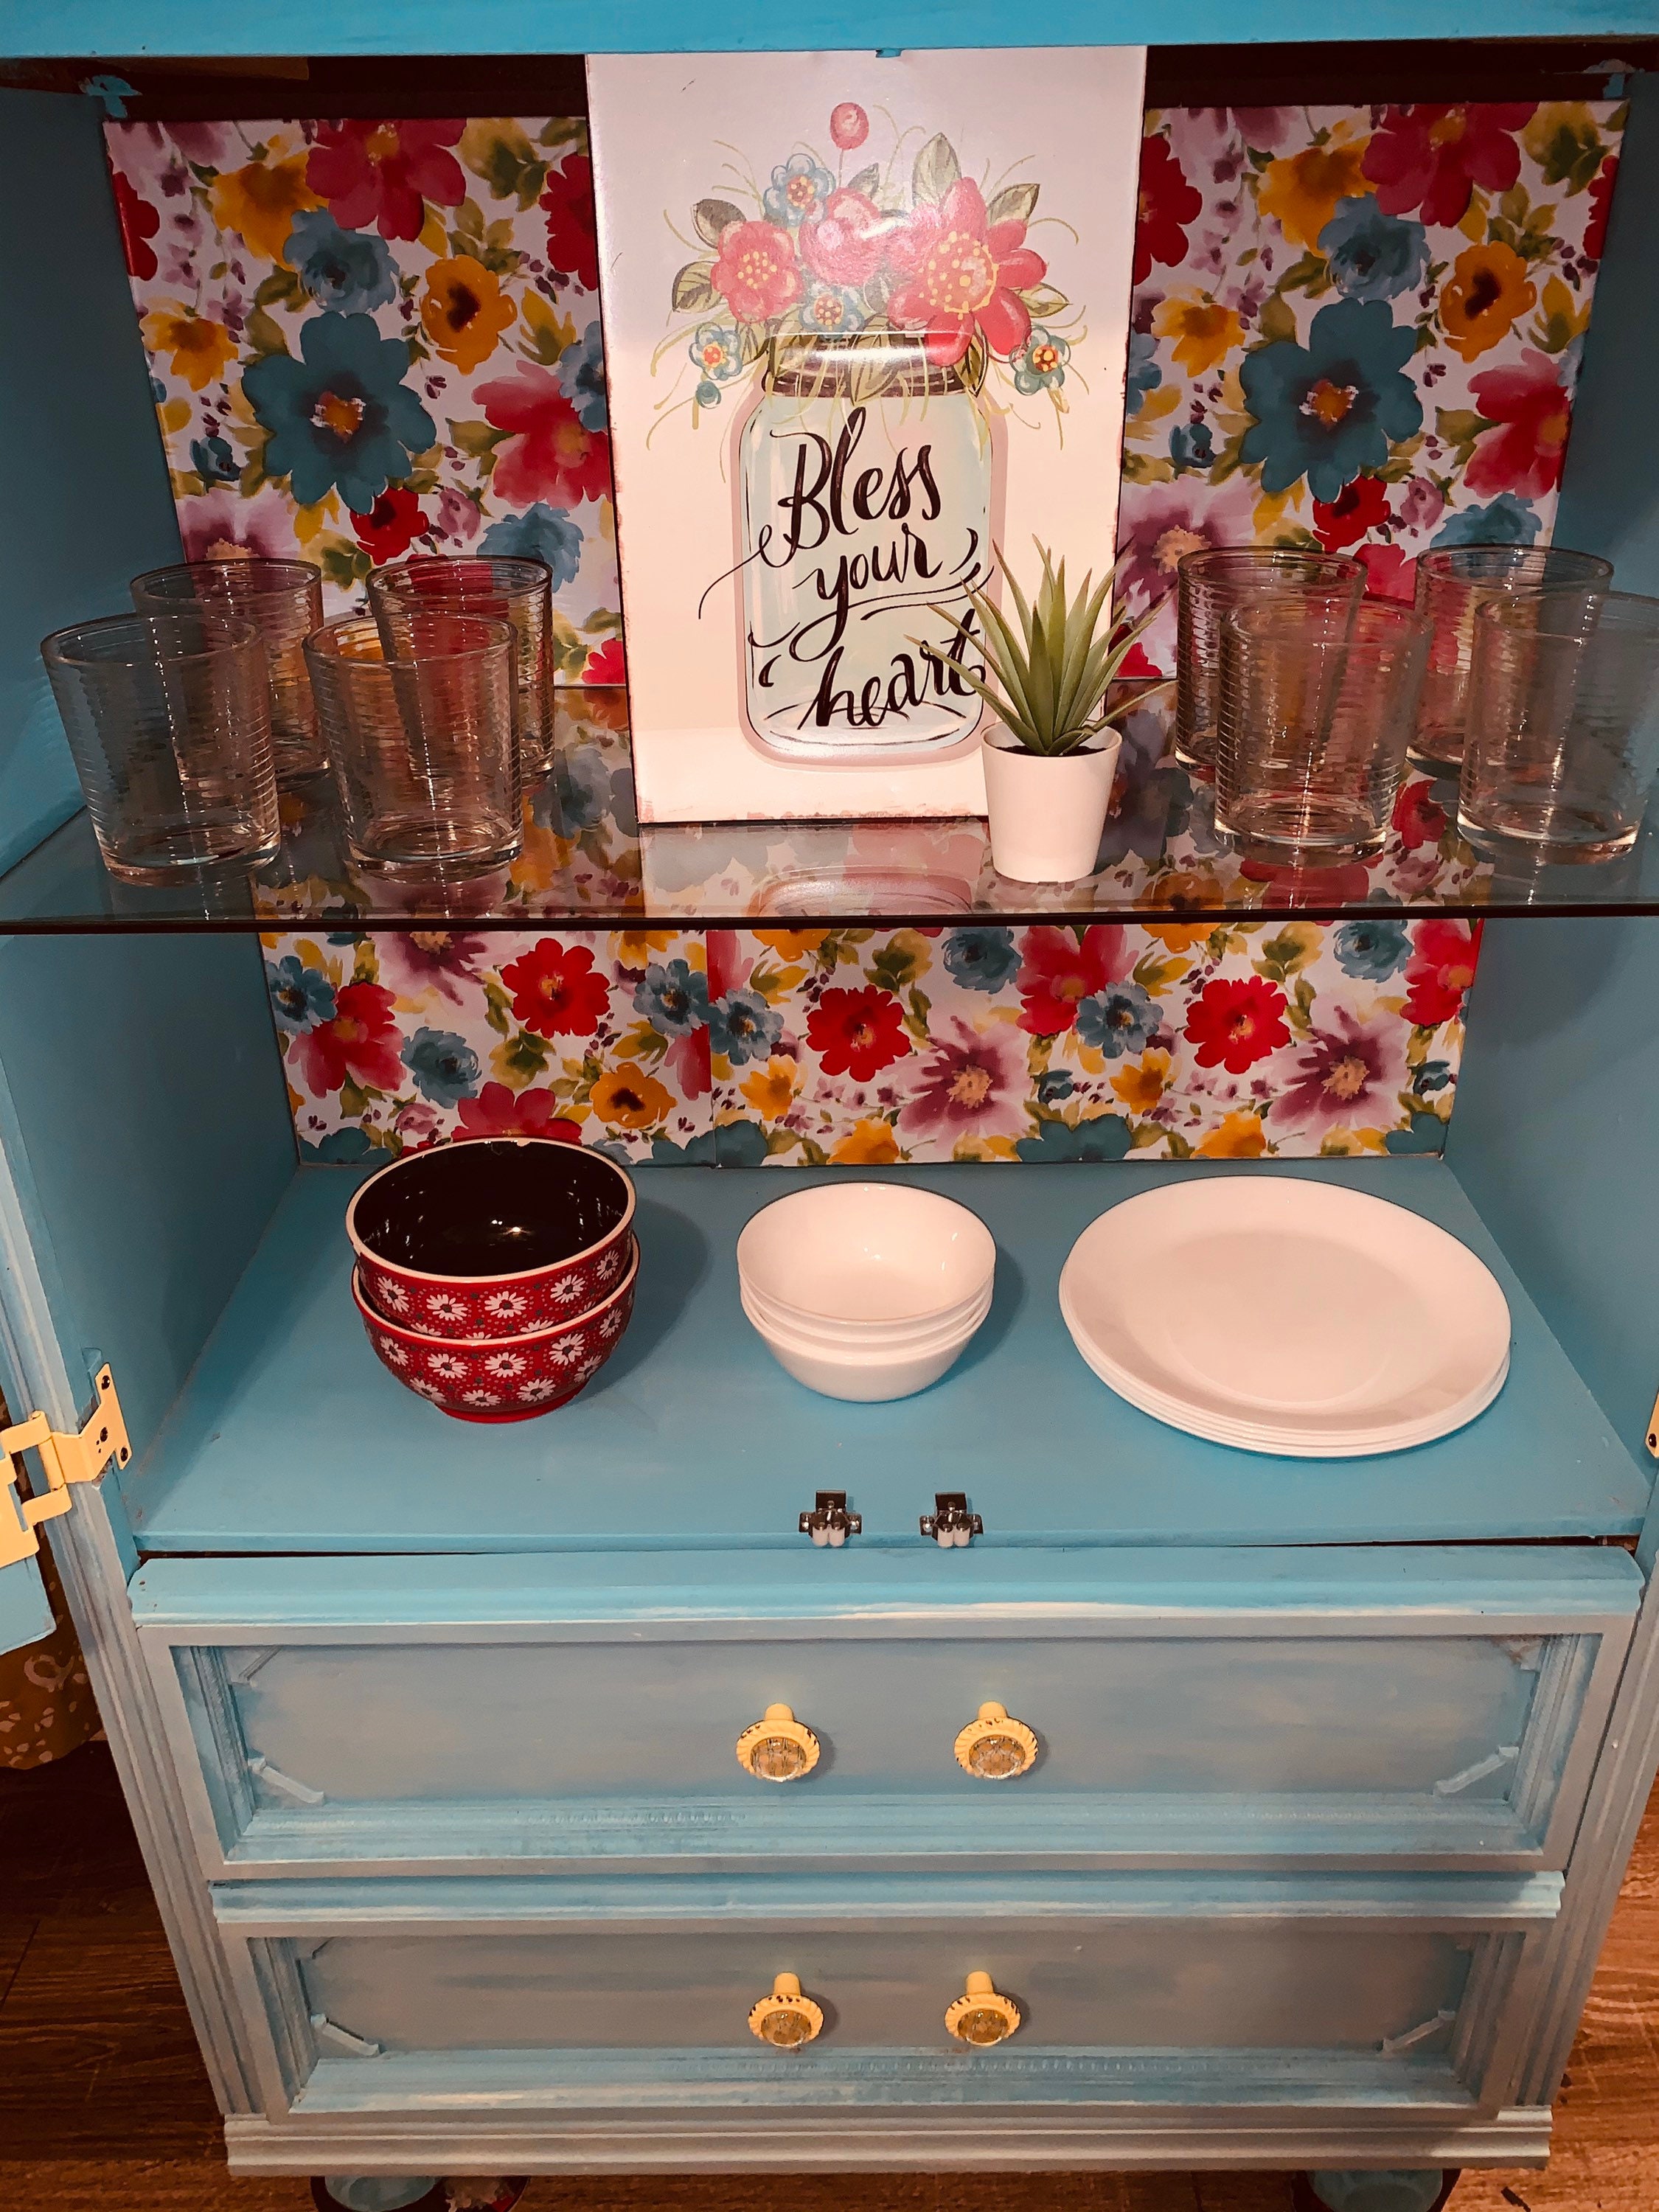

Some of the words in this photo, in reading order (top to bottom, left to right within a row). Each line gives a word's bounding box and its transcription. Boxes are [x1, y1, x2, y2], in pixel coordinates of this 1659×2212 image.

[758, 406, 942, 568] Bless
[790, 522, 945, 662] your
[798, 608, 987, 730] heart
